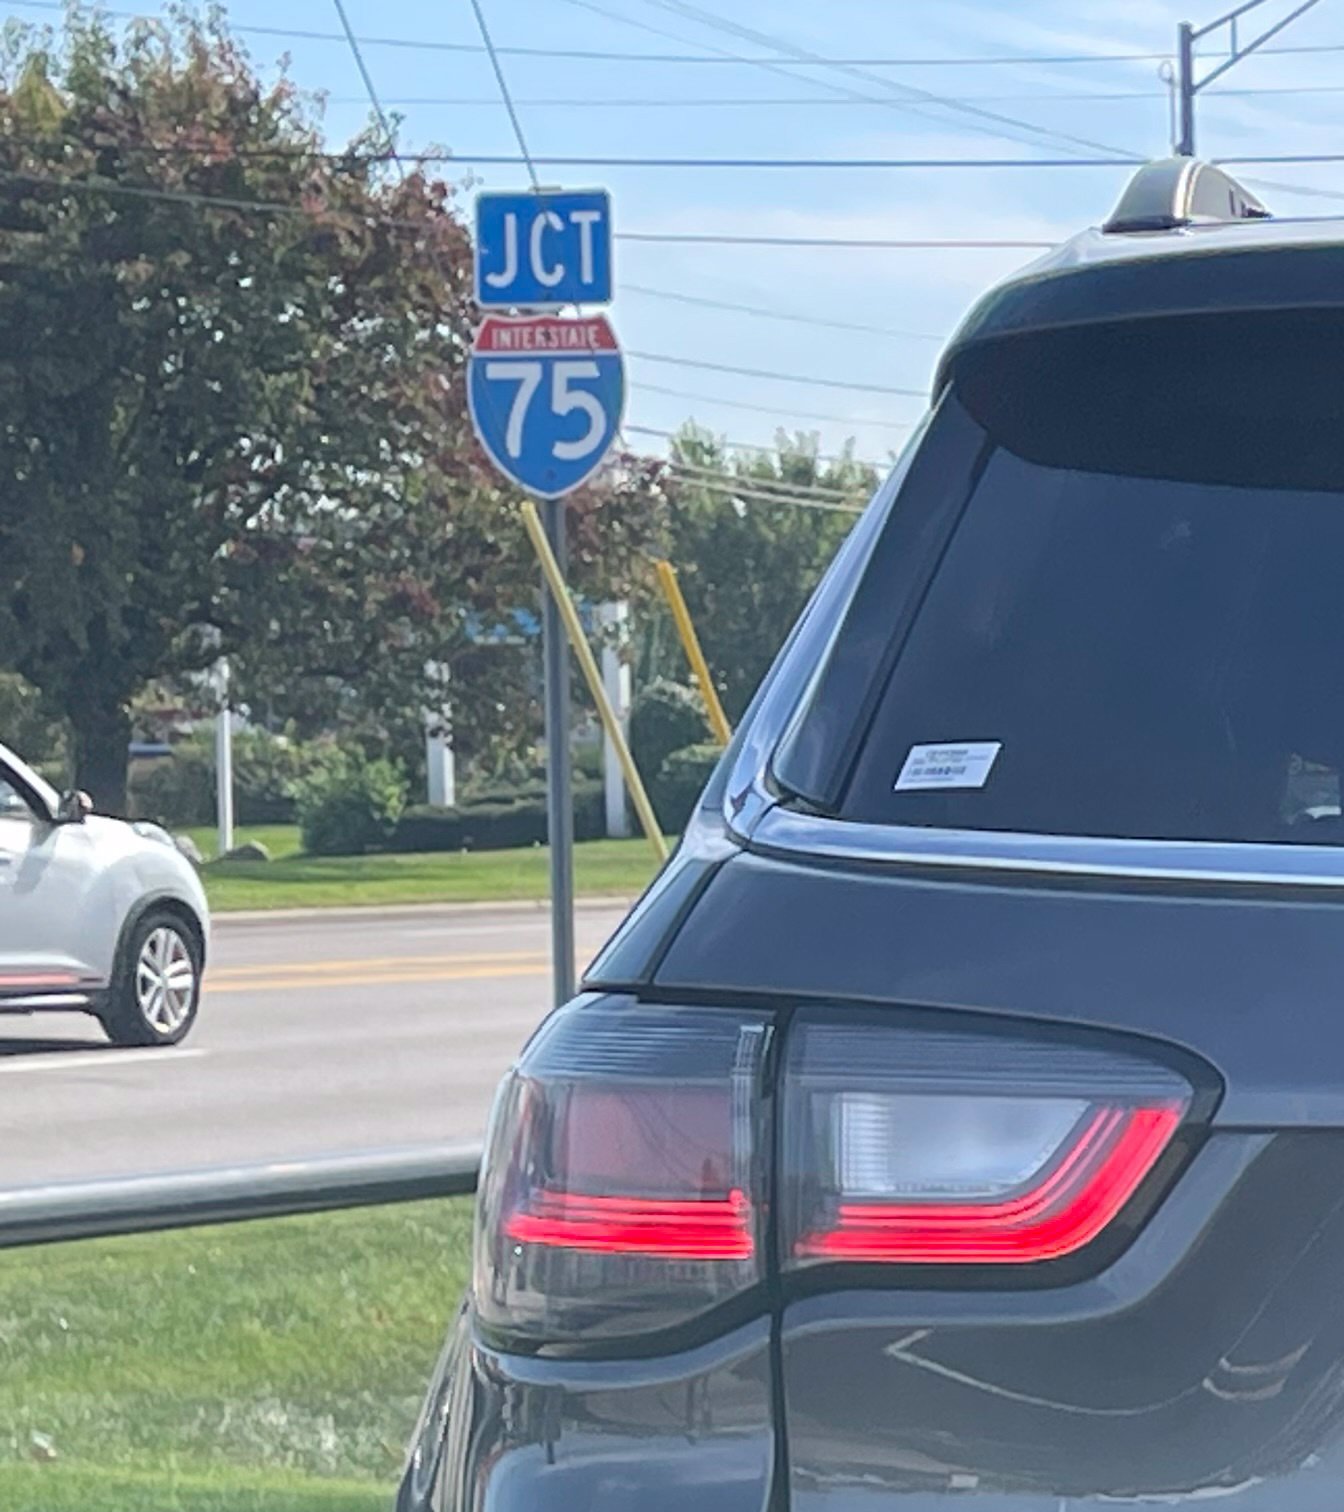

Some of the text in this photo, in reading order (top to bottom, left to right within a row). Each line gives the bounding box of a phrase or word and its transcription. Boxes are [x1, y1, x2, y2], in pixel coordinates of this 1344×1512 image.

[485, 210, 601, 289] JCT
[491, 324, 600, 350] INTERSTATE
[485, 360, 607, 461] 75
